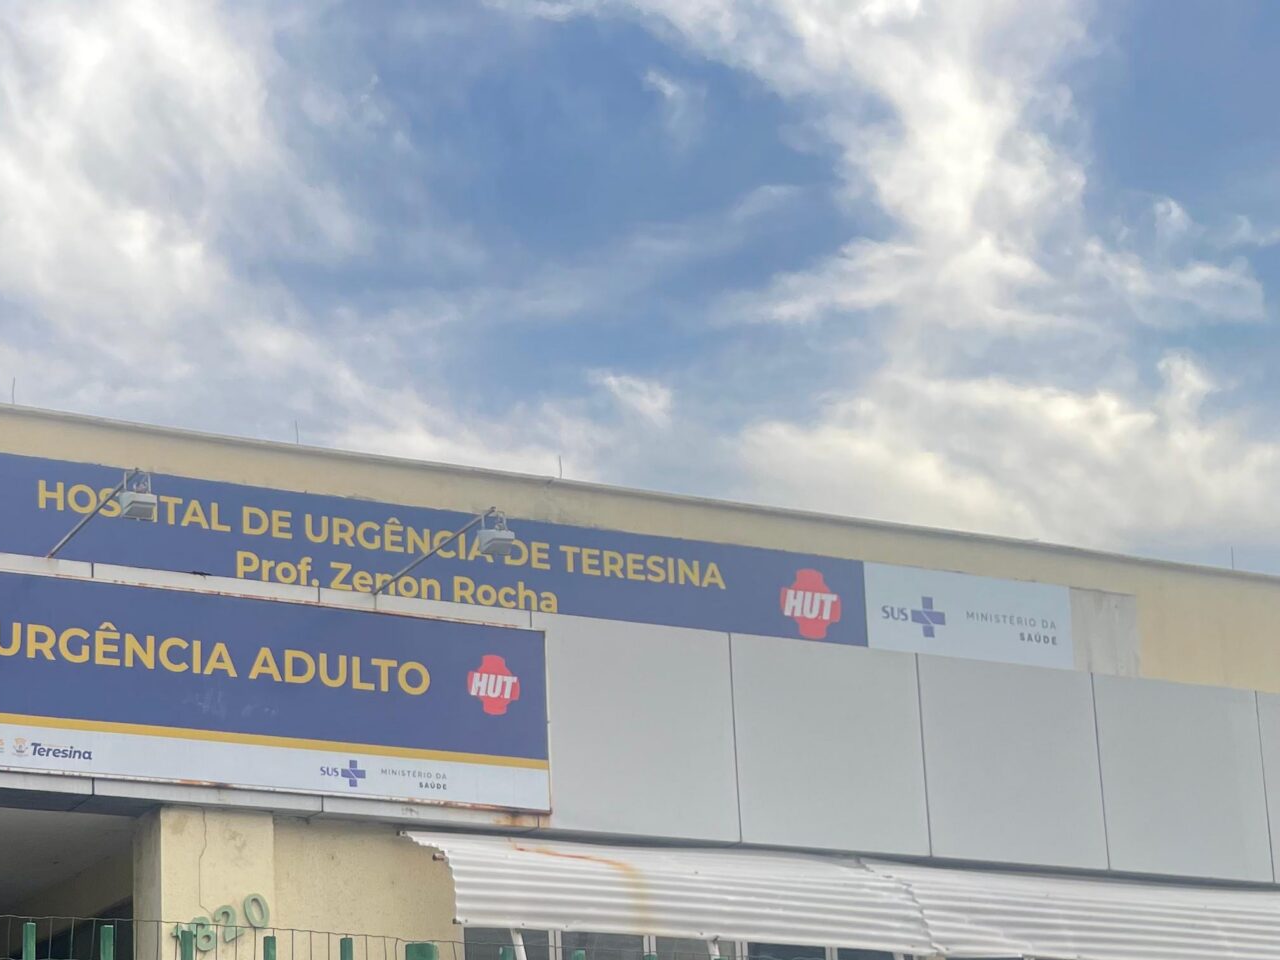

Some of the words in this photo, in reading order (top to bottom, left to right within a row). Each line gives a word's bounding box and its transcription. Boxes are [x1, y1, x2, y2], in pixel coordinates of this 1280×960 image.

[38, 480, 231, 532] HOSTAL
[242, 506, 293, 539] DE
[504, 538, 551, 570] DE
[559, 545, 726, 590] TERESINA
[236, 551, 319, 587] Prof.
[330, 561, 441, 600] Zenon
[453, 575, 558, 614] Rocha
[881, 605, 909, 621] SUS
[1041, 618, 1057, 630] DA
[1019, 632, 1058, 645] SAÚDE
[248, 646, 431, 696] ADULTO
[31, 742, 93, 761] Teresina
[320, 766, 339, 777] SUS
[381, 768, 432, 780] MINISTÉRIO
[435, 772, 448, 780] DA
[419, 781, 448, 791] SAÚDE
